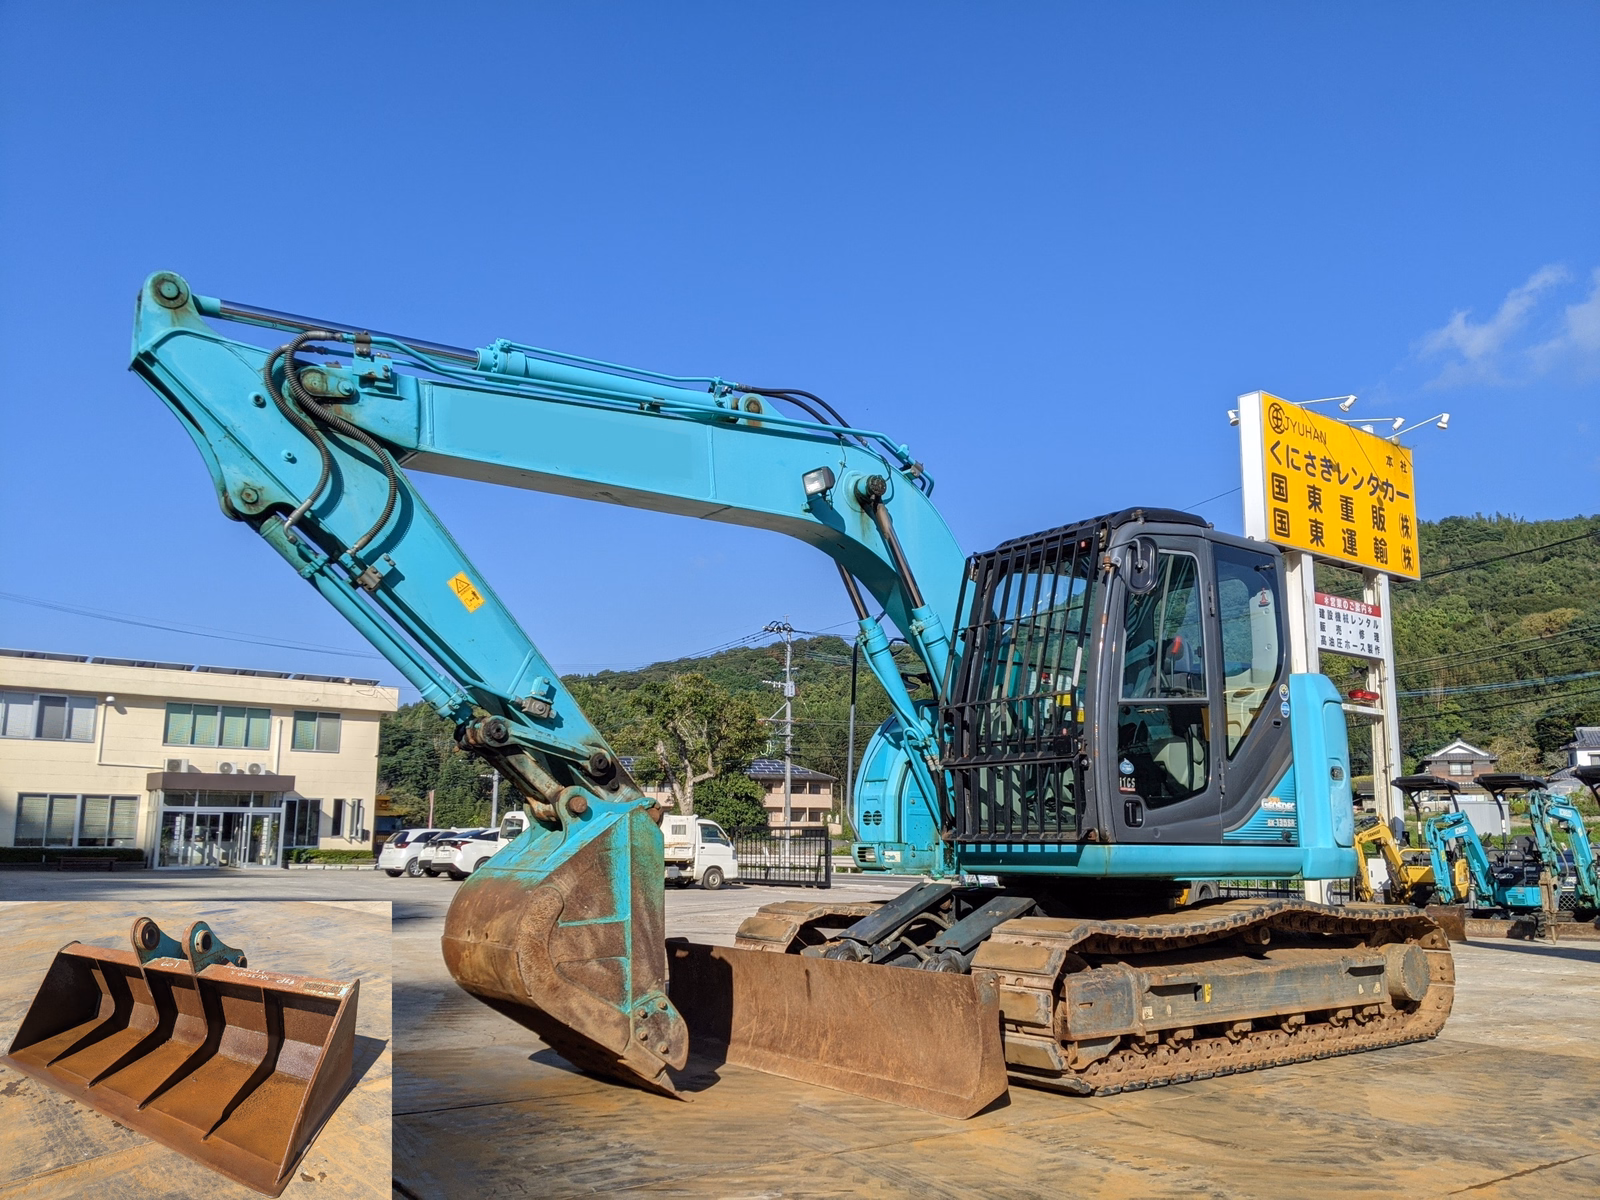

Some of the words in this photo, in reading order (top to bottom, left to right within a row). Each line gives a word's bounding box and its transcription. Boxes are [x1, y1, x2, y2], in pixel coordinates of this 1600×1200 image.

[1284, 415, 1327, 445] JYUHAN
[1270, 439, 1410, 503] くにさきレンタカー
[1385, 454, 1408, 474] 本社
[1318, 608, 1379, 629] 建設機械レンタル
